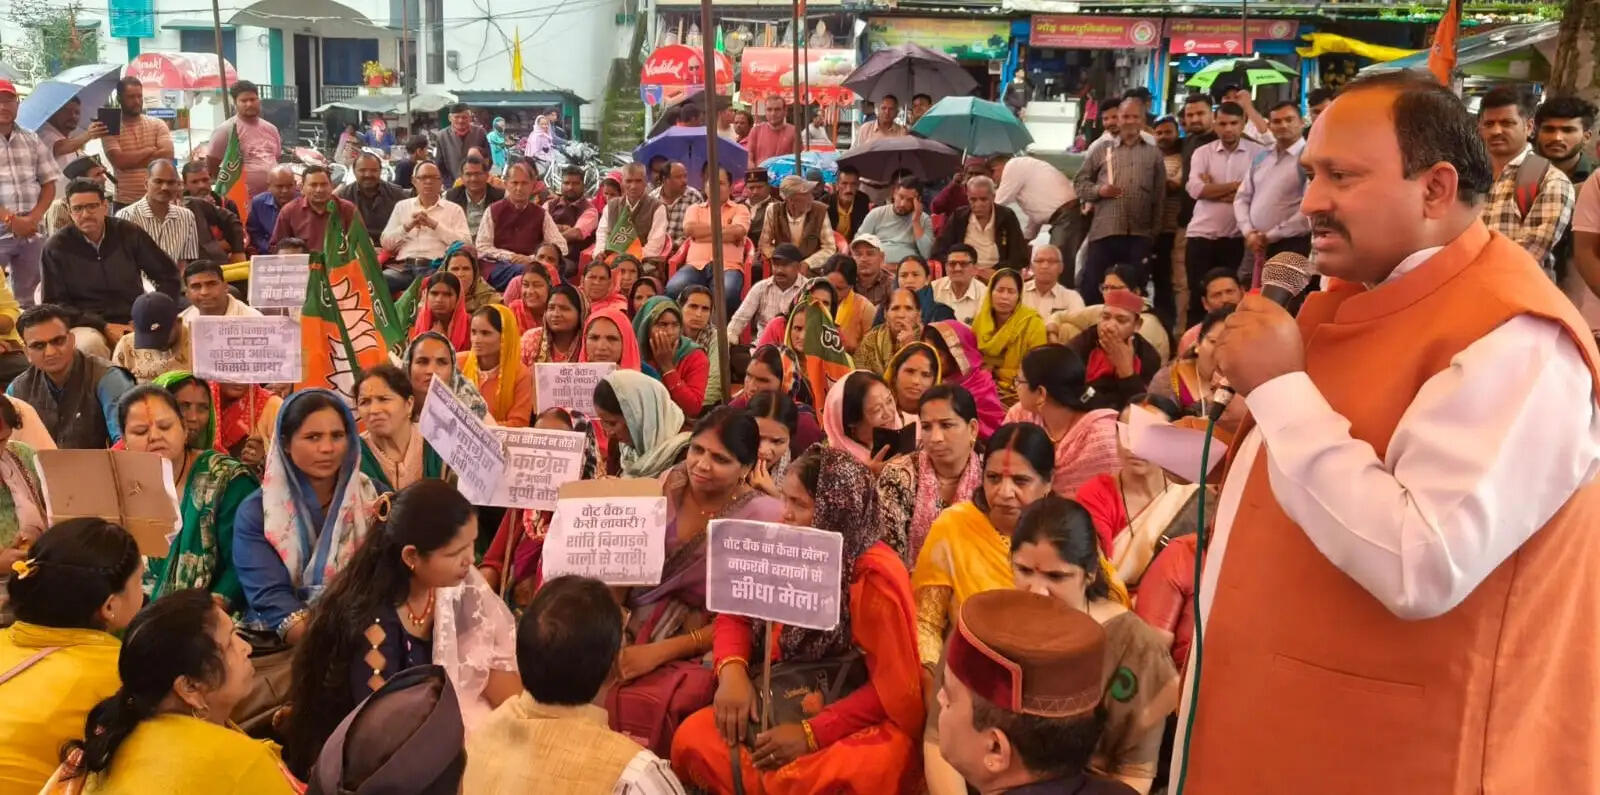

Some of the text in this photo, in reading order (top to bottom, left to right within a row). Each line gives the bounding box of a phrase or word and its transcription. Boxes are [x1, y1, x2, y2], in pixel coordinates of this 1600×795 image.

[645, 58, 684, 79] Vadilal
[513, 450, 570, 473] कांग्रेस
[509, 486, 535, 503] चुप्पी
[582, 504, 601, 517] वोट
[567, 548, 596, 565] वालों
[599, 549, 611, 565] से
[723, 537, 741, 550] वोट
[761, 542, 775, 555] का
[801, 546, 830, 562] खेल?
[810, 566, 823, 583] से
[731, 575, 819, 612] सीधा मेल!
